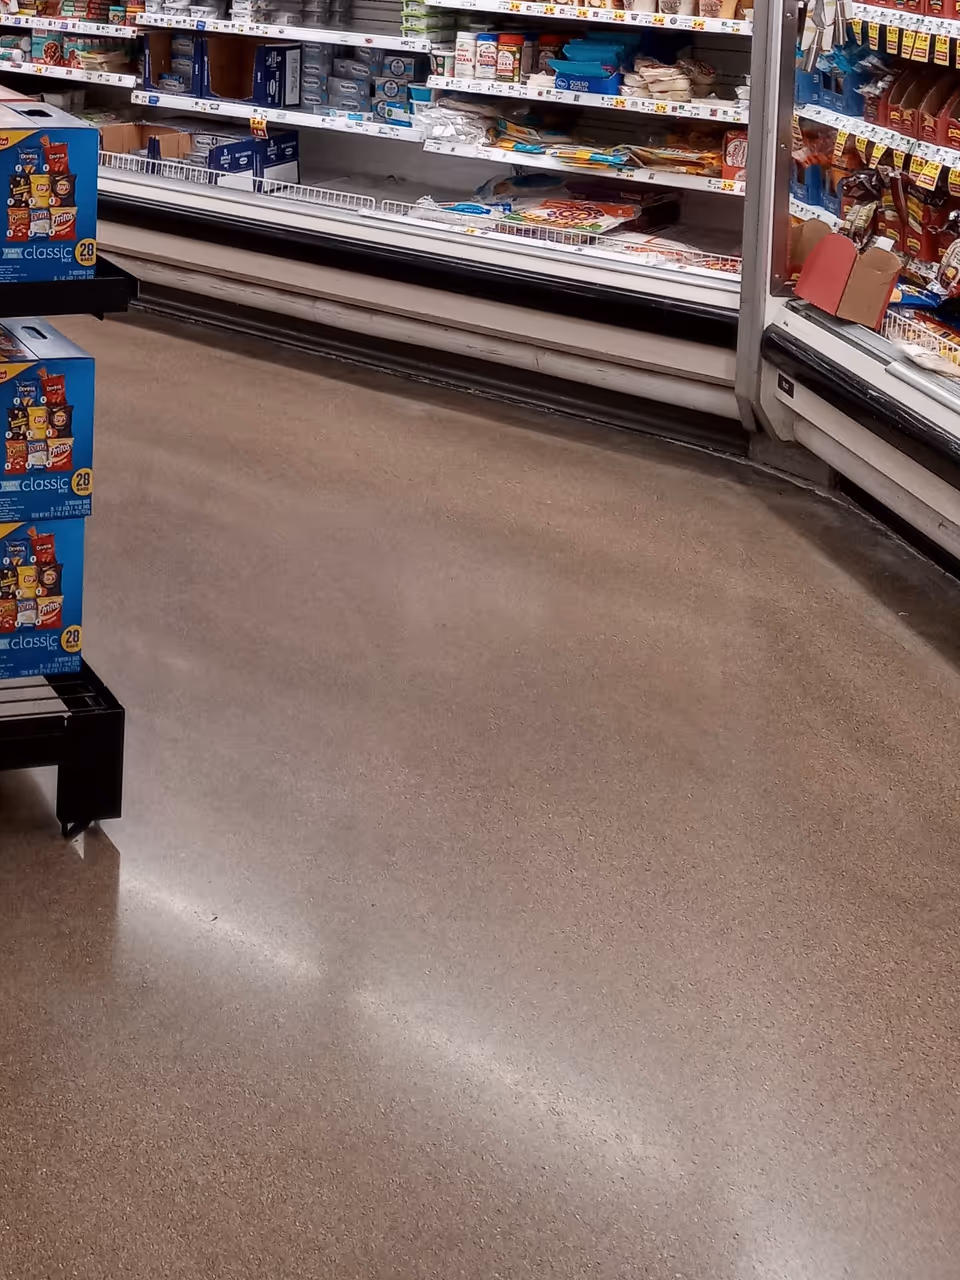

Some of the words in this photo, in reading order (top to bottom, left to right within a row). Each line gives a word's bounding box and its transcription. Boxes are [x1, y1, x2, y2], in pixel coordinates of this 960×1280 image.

[24, 245, 72, 259] classic
[80, 243, 94, 257] 28
[22, 475, 68, 491] classic
[76, 472, 90, 487] 28
[11, 633, 58, 649] classic
[66, 630, 79, 643] 28
